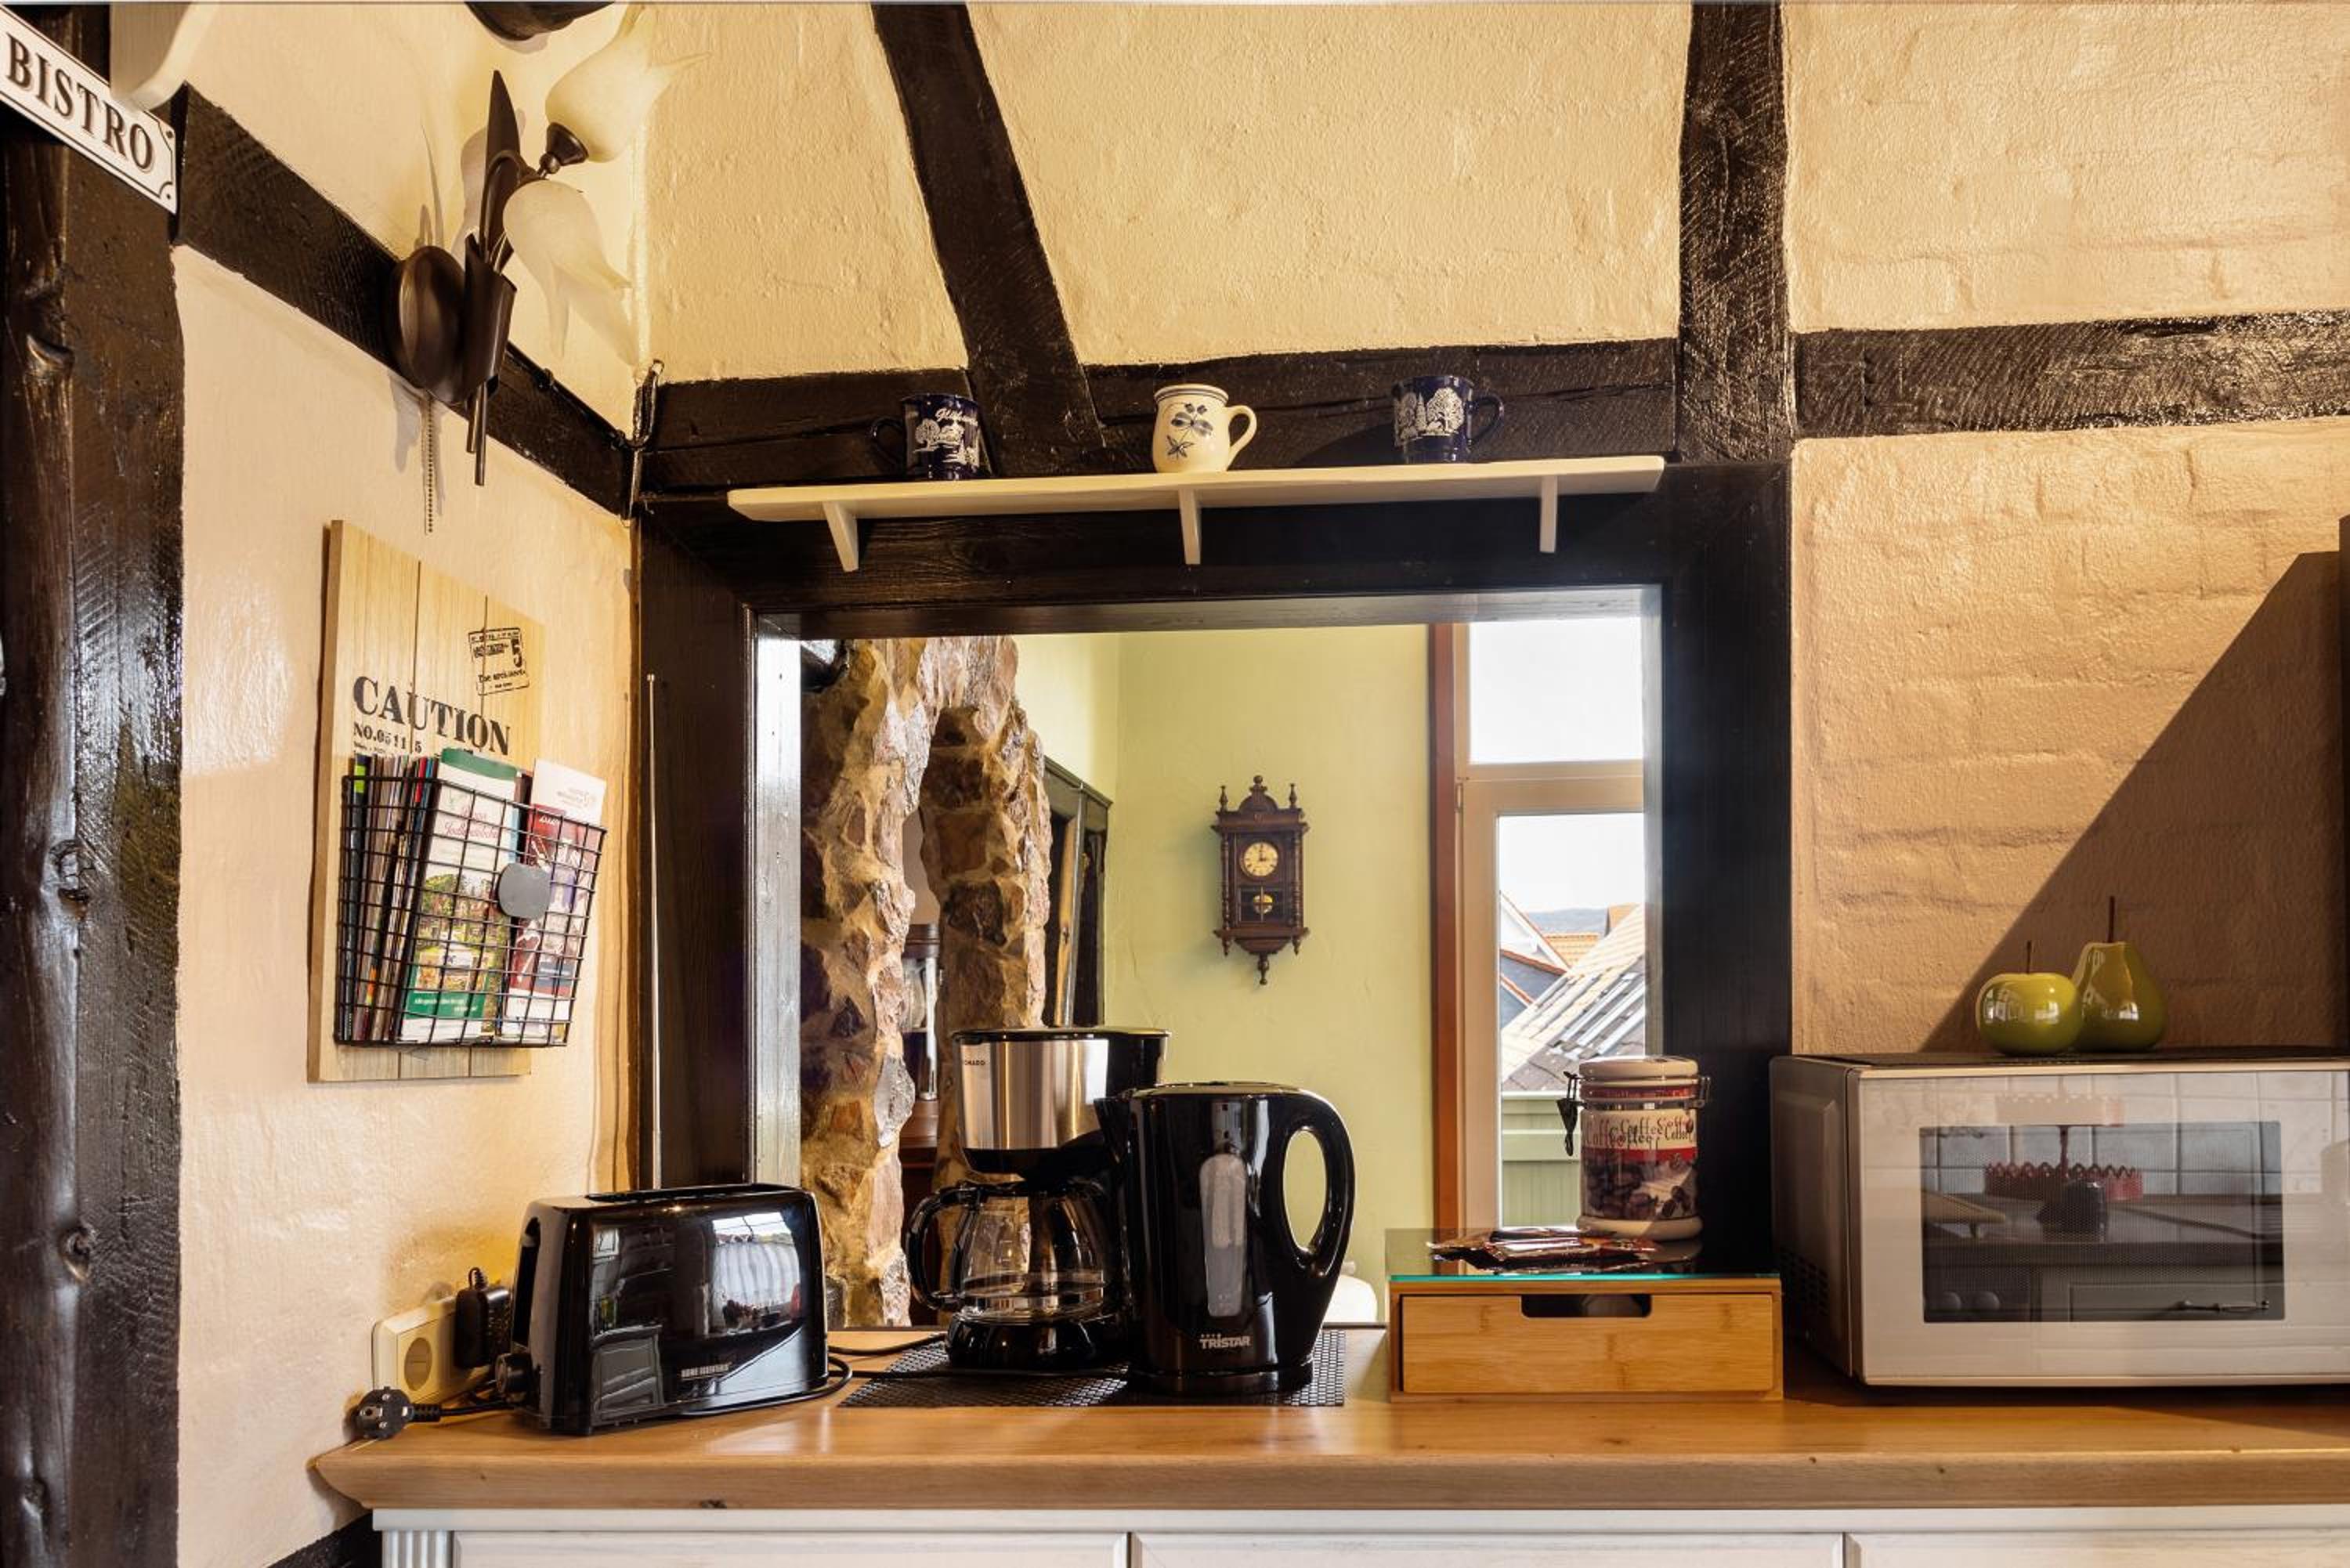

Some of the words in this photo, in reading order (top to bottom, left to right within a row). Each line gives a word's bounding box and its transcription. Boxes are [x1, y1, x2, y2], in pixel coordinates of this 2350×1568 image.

[6, 32, 154, 172] BISTRO
[352, 676, 512, 756] CAUTION
[1199, 1333, 1251, 1349] TRISTAR
